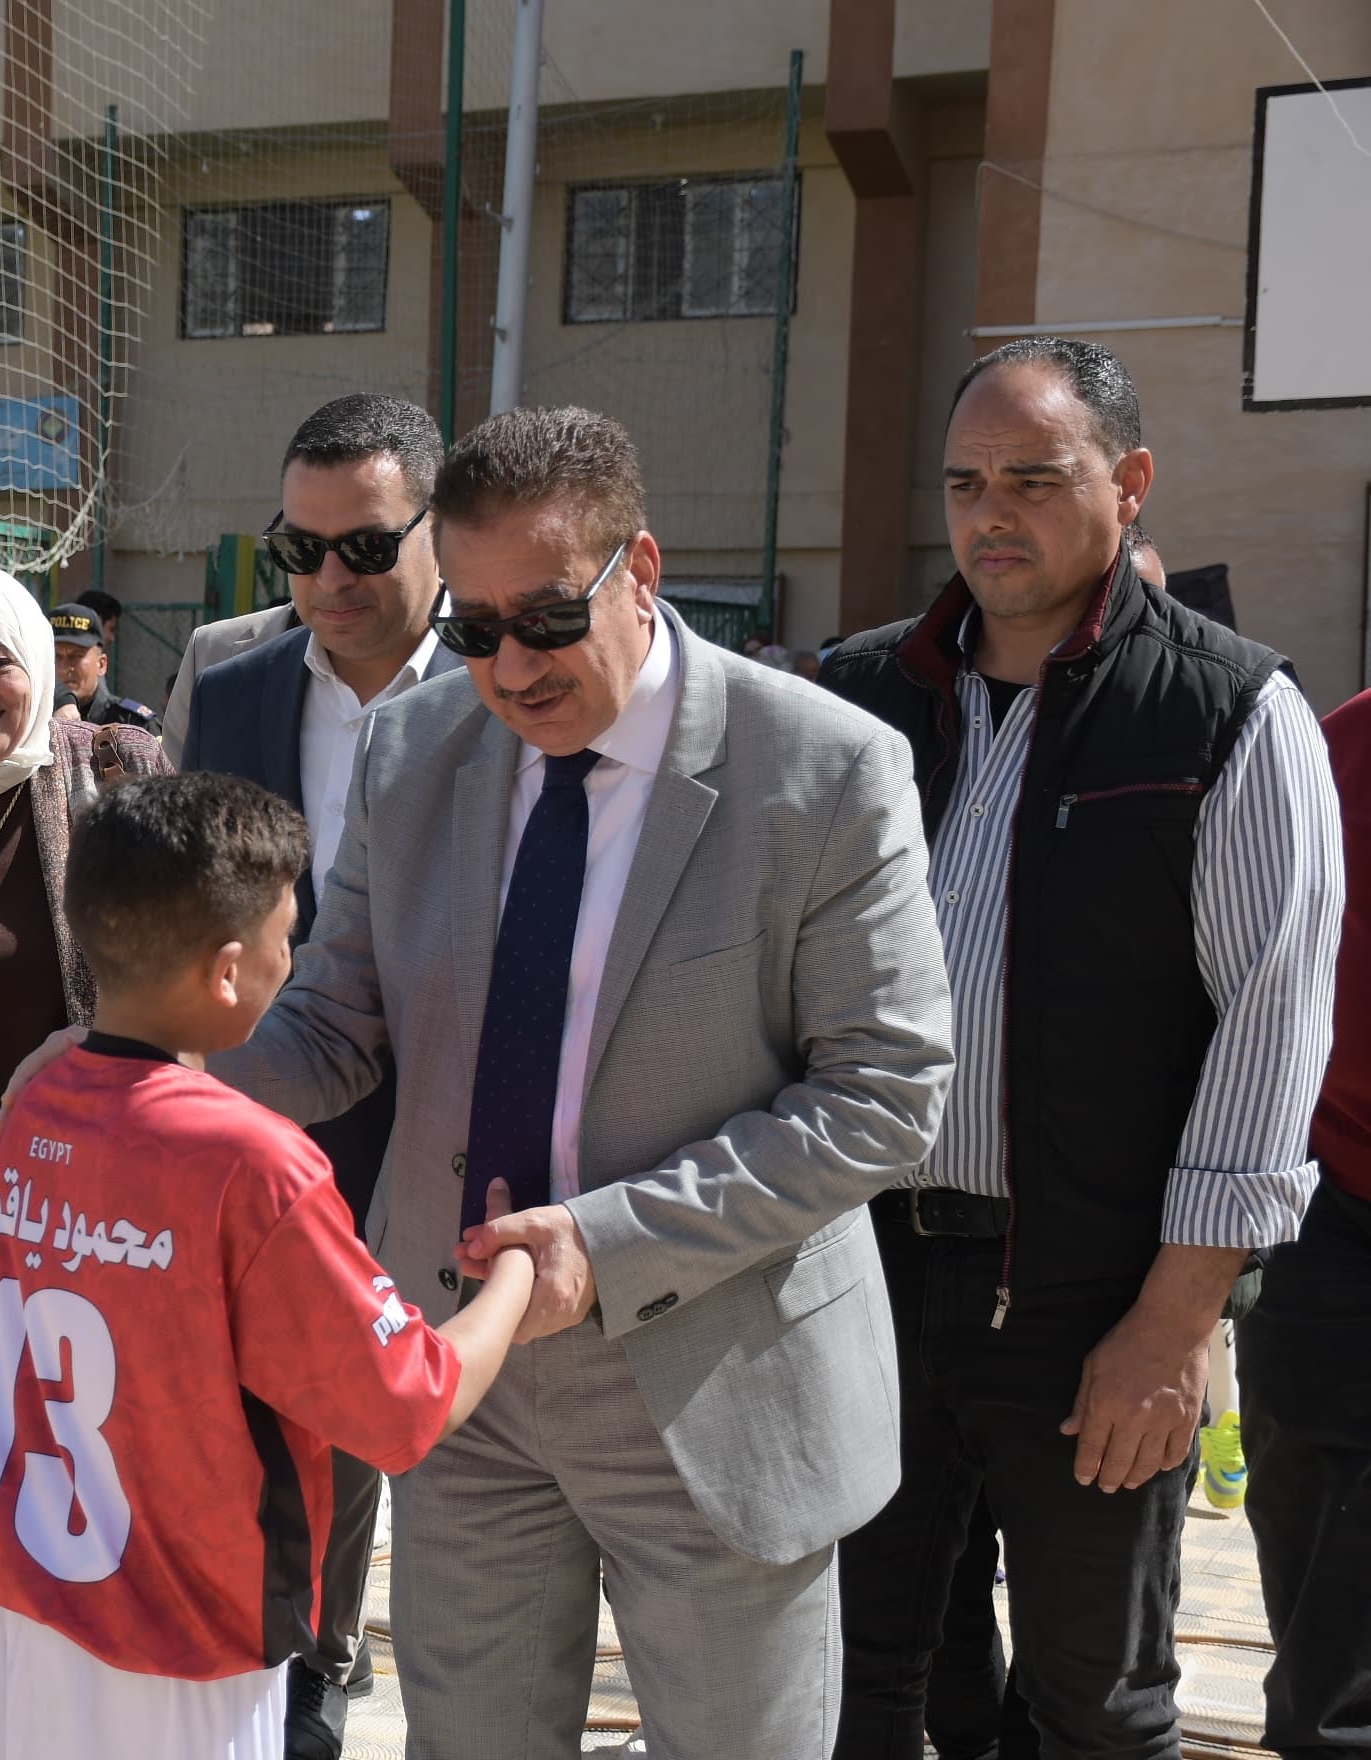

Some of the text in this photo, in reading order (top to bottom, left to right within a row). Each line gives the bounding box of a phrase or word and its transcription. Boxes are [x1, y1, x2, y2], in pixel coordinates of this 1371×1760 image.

[50, 615, 91, 631] POLICE
[29, 1136, 73, 1165] EGYPT
[52, 1200, 173, 1272] محمود
